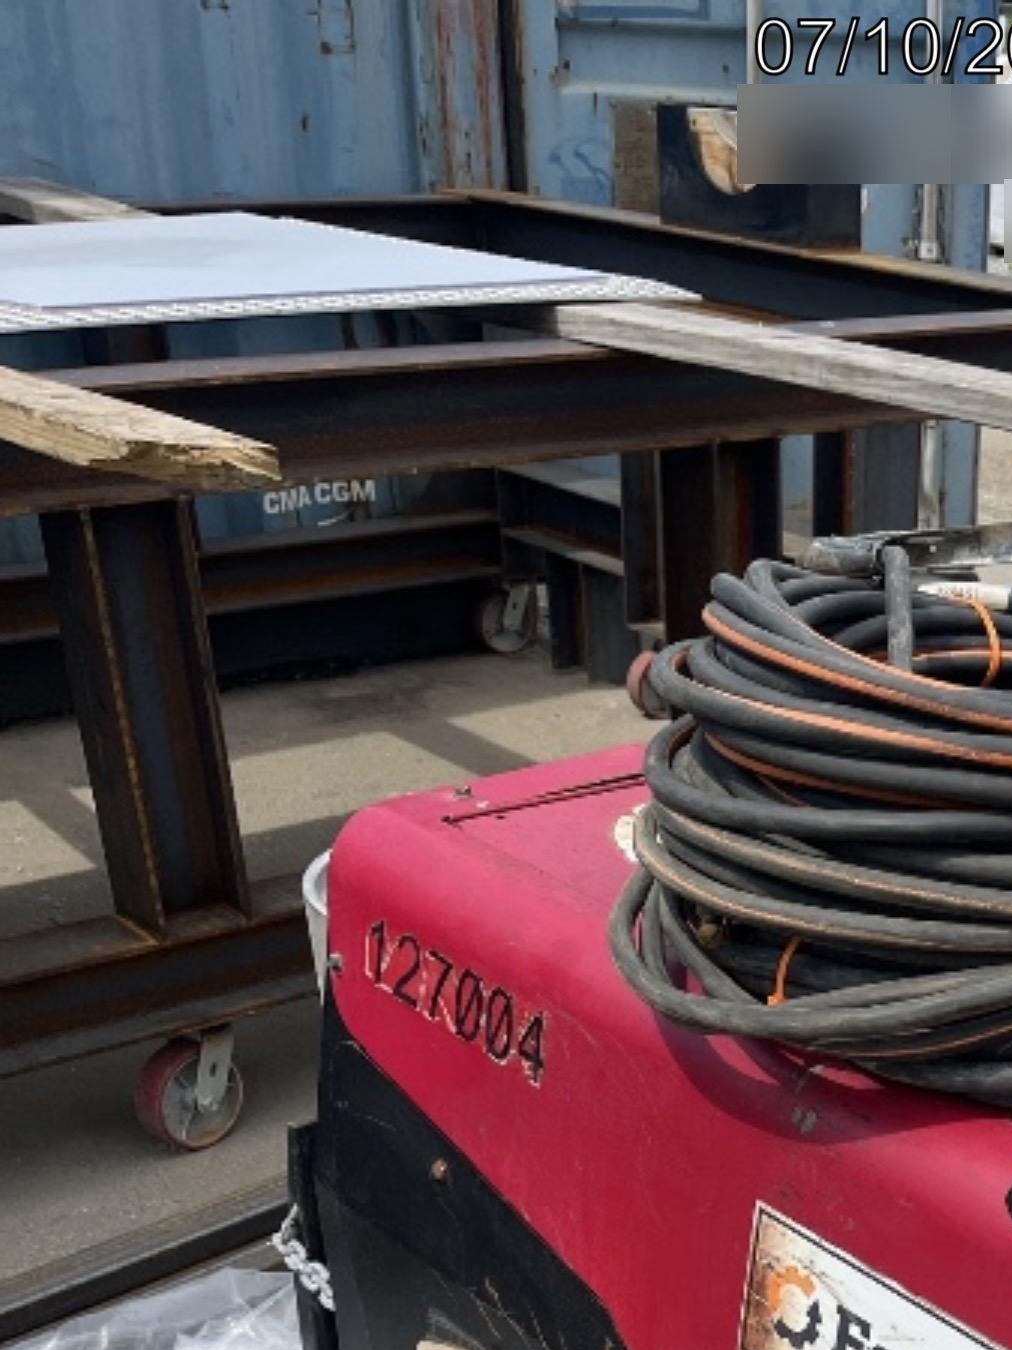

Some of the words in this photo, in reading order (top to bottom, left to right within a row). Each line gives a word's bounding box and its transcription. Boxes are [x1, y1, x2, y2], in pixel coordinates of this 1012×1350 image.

[263, 485, 312, 514] CMA
[314, 479, 376, 504] CGM
[366, 920, 545, 1085] 127004
